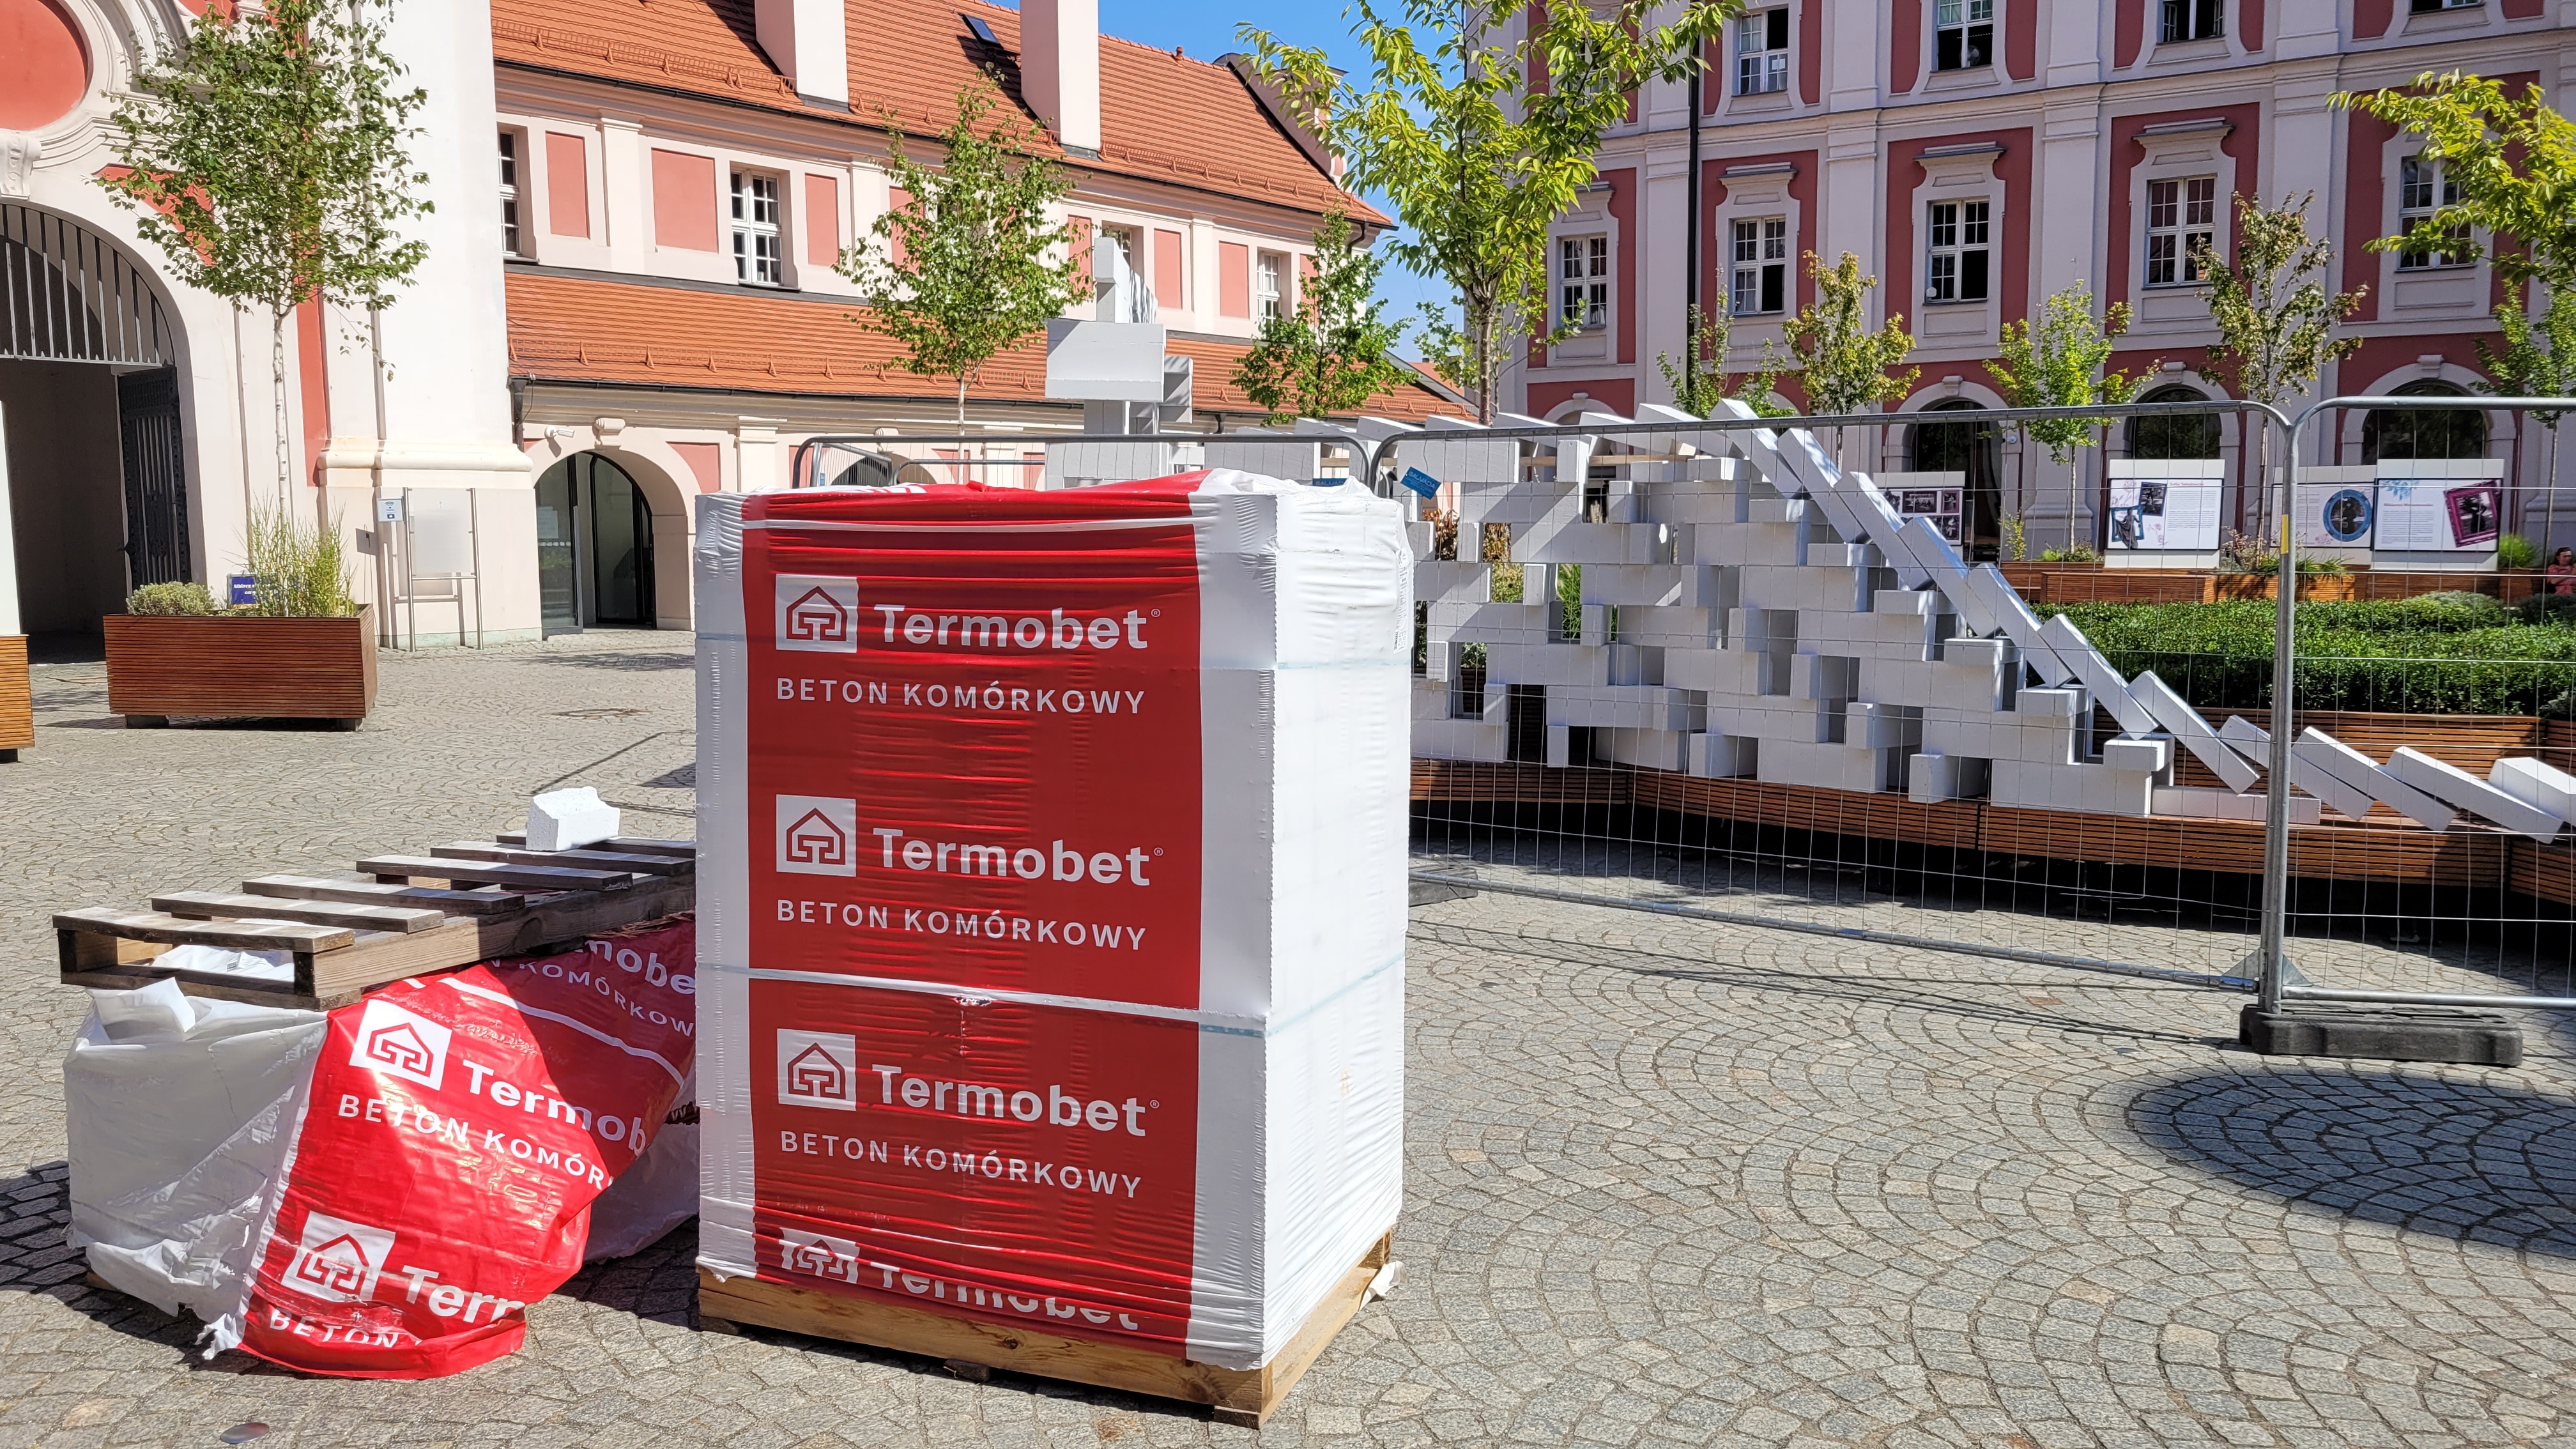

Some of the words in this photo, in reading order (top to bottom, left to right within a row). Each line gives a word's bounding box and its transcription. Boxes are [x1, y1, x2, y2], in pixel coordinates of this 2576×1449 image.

[777, 677, 888, 705] BETON
[903, 680, 1146, 715] KOMÓRKOWY
[777, 900, 889, 930] BETON
[904, 909, 1147, 951] KOMÓRKOWY
[338, 1093, 470, 1143] BETON
[482, 1128, 614, 1192] KOMÓR
[780, 1130, 889, 1164] BETON
[903, 1144, 1142, 1199] KOMÓRKOWY
